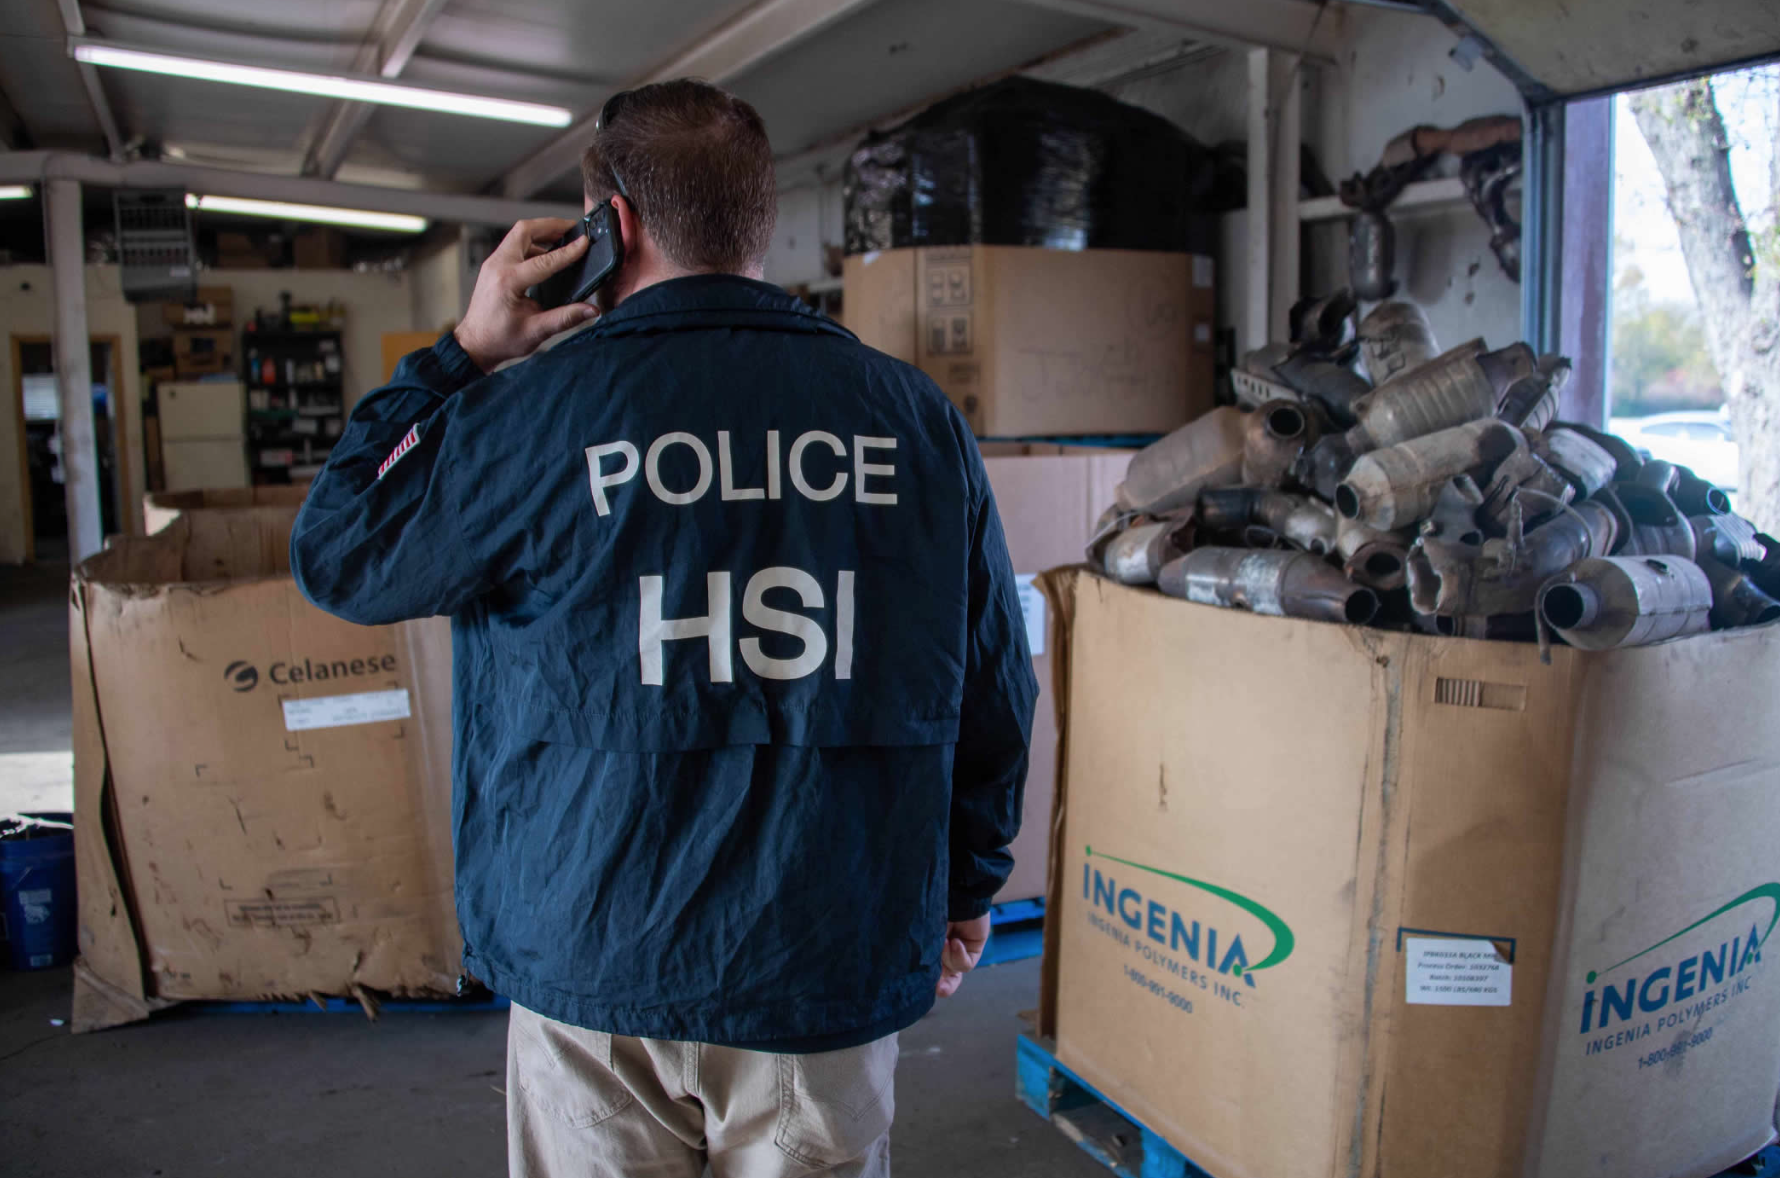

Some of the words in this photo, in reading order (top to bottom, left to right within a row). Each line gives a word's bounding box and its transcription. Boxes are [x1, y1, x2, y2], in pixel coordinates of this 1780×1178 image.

[584, 430, 898, 516] POLICE
[639, 566, 855, 686] HSI
[269, 654, 397, 685] Celanese
[1083, 862, 1257, 989] INGENIA
[1087, 910, 1131, 946] INGENIA
[1135, 940, 1208, 990] POLYMERS
[1579, 922, 1762, 1035] INGENIA
[1585, 1023, 1651, 1056] INGENIA
[1657, 988, 1728, 1033] POLYMERS
